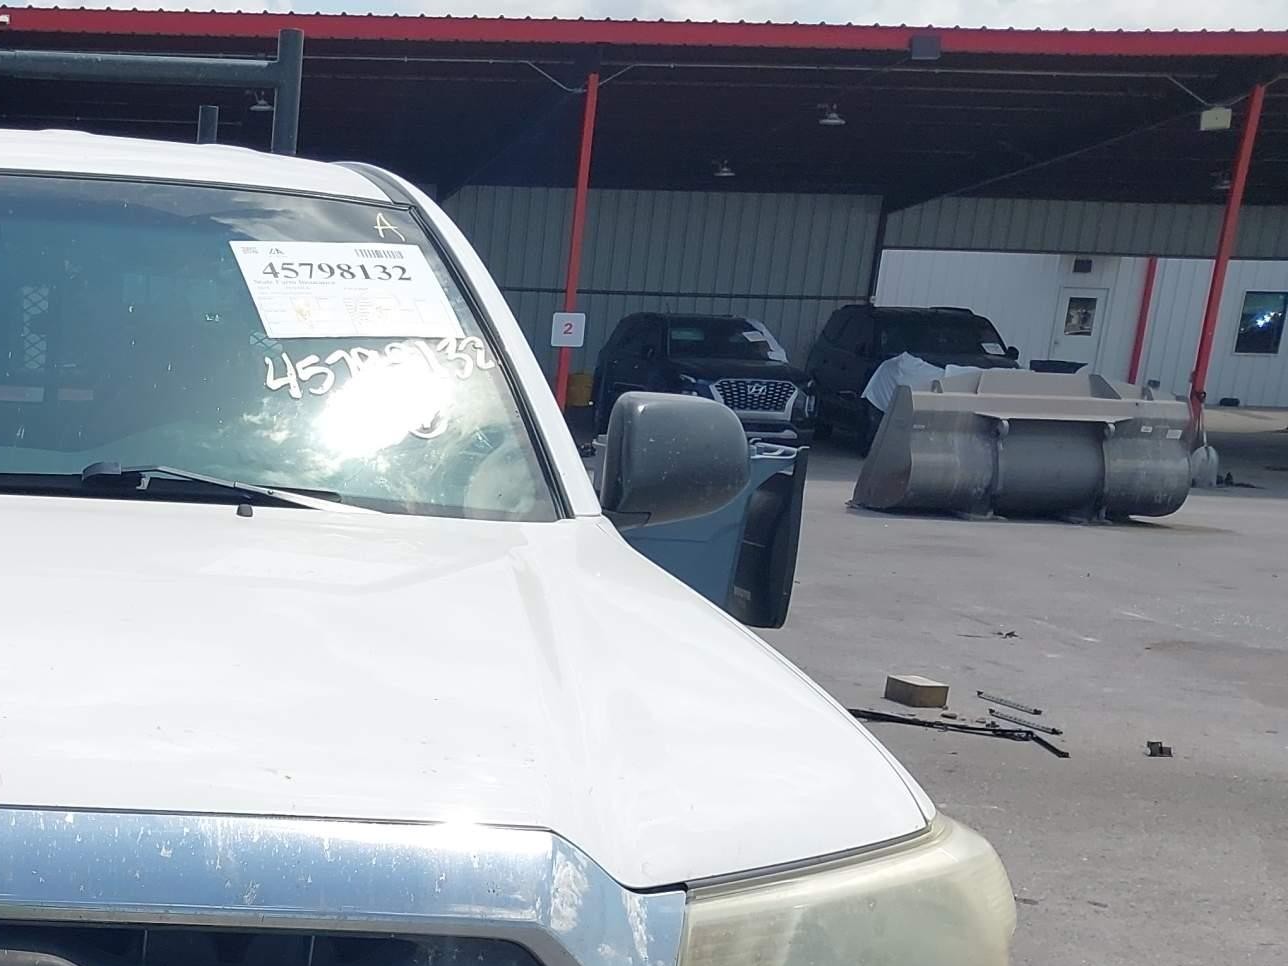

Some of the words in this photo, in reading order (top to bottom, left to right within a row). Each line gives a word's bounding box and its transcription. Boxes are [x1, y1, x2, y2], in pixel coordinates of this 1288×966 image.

[373, 212, 406, 242] A
[262, 261, 413, 281] 45798132
[563, 322, 573, 335] 2
